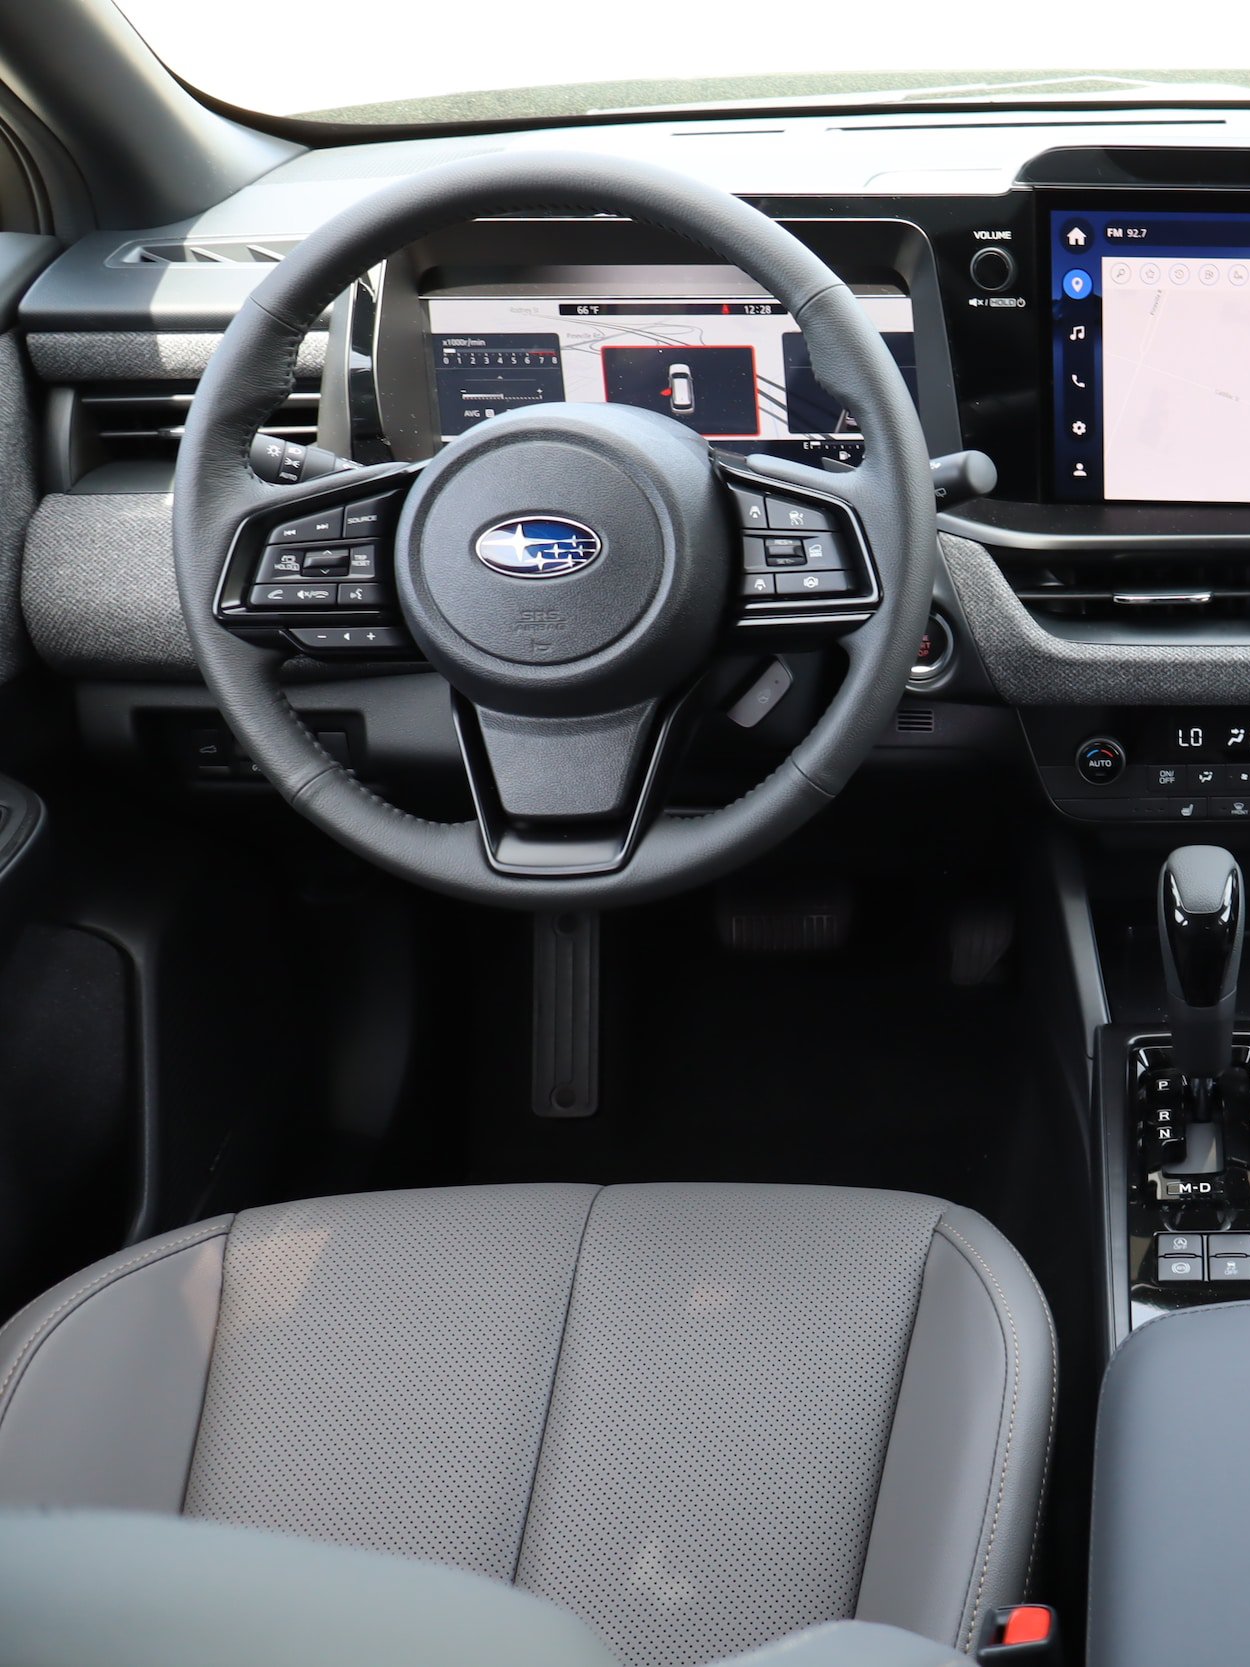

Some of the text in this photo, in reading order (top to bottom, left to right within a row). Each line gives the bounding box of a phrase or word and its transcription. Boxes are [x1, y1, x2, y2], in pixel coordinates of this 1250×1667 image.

[973, 230, 1012, 240] VOLUME
[1106, 227, 1147, 238] FM 92.7
[744, 305, 772, 315] 12:28
[442, 338, 486, 347] x1000r/min
[443, 356, 558, 365] 0 1 2 3 4 5 6 7 8
[464, 409, 481, 418] AVG
[803, 441, 809, 450] E
[347, 514, 378, 525] SOURCE
[520, 609, 561, 621] SRS
[1178, 727, 1203, 747] LO
[1088, 759, 1112, 768] AUTO
[1159, 770, 1175, 778] ON/
[1158, 777, 1176, 785] OFF
[1158, 1081, 1169, 1090] P
[1159, 1111, 1171, 1121] R
[1159, 1128, 1171, 1138] N
